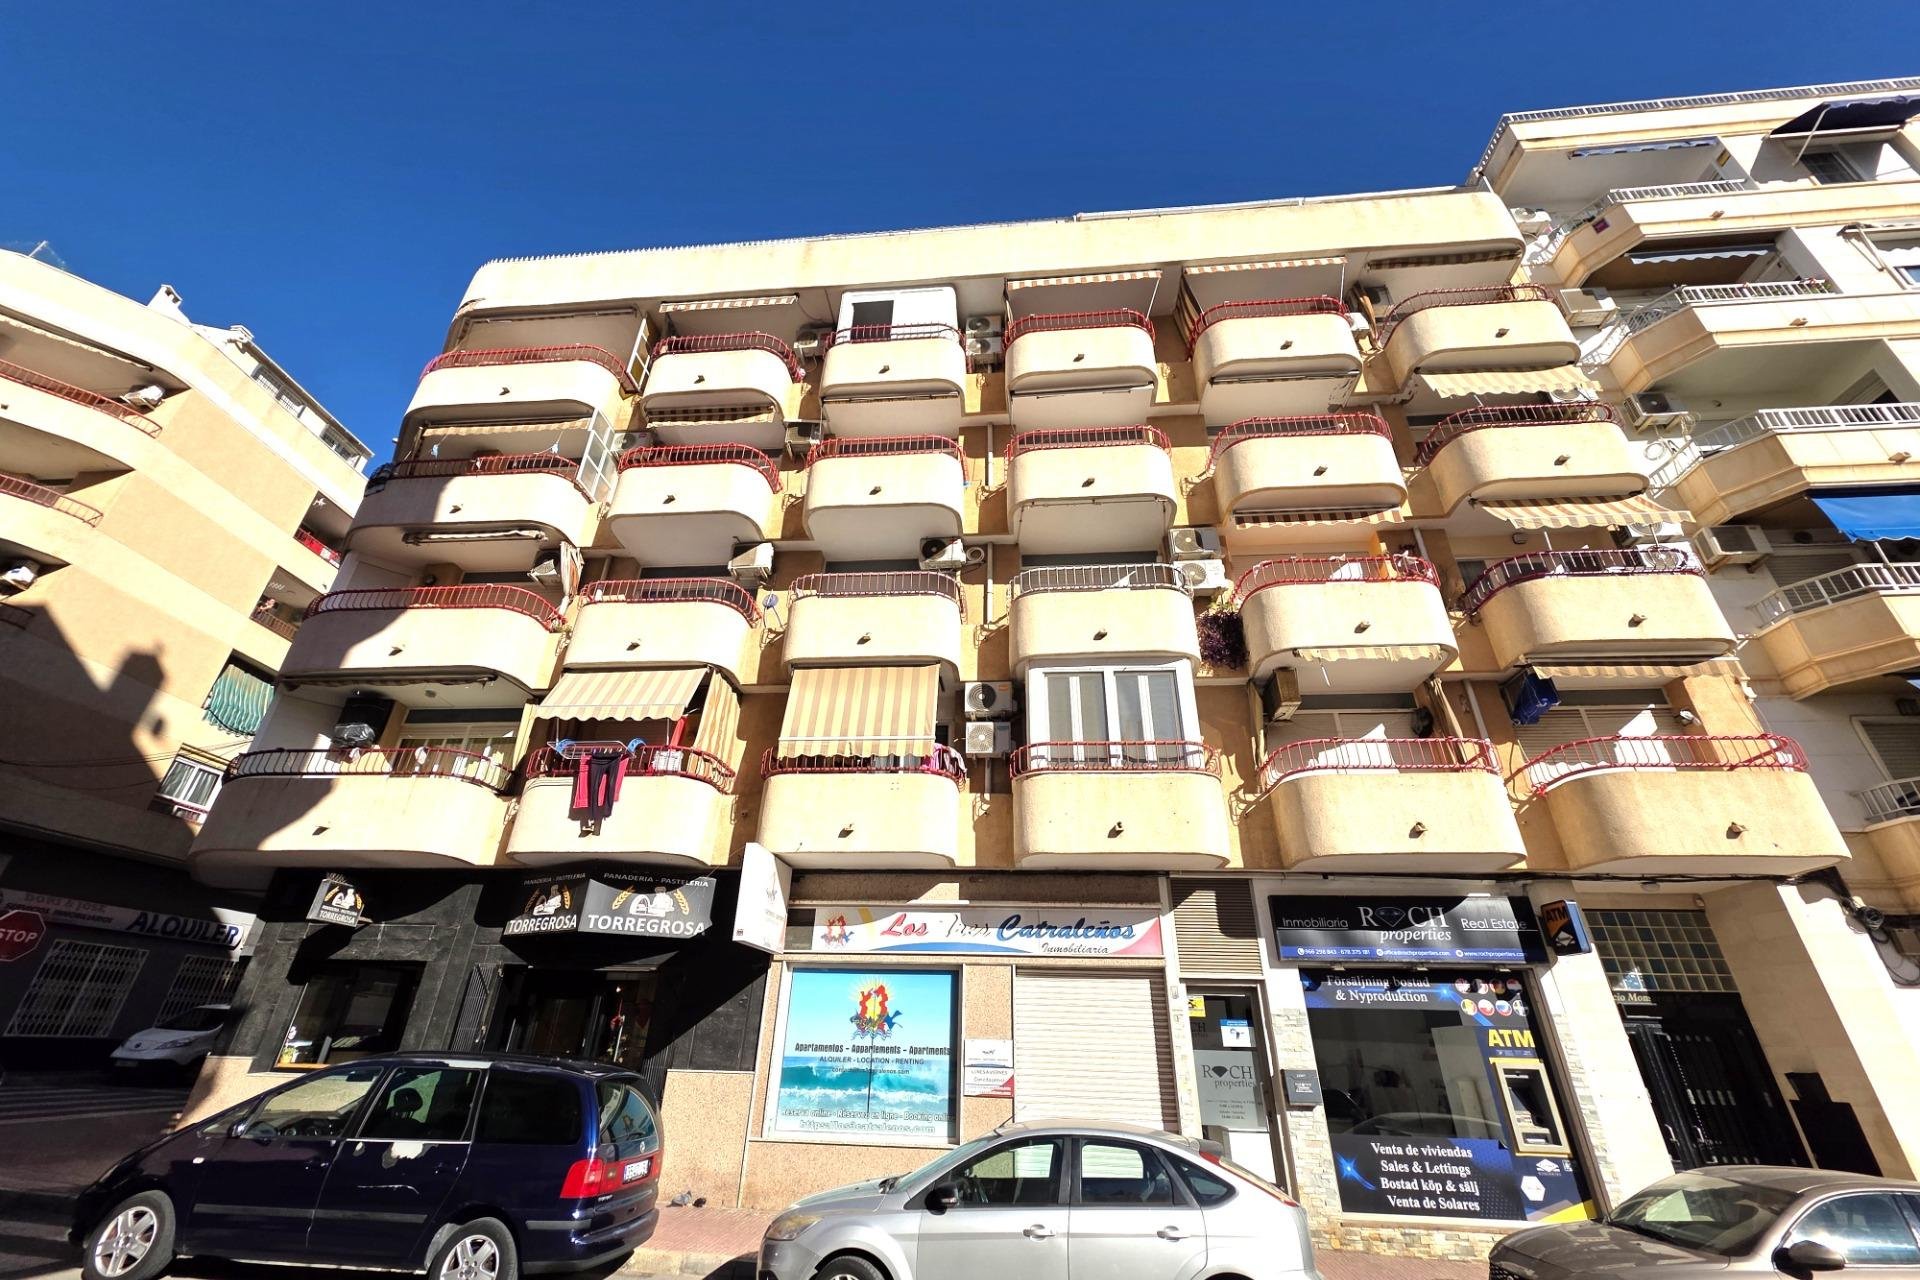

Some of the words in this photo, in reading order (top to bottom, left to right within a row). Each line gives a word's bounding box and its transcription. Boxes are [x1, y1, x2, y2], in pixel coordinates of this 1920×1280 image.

[603, 873, 654, 882] PANADERIA
[660, 878, 709, 887] PASTELERIA
[1545, 905, 1569, 921] ATM
[126, 911, 240, 945] ALQUILER
[509, 914, 578, 933] TORREGROSA
[588, 914, 706, 936] TORREGROSA
[880, 913, 929, 937] Los
[996, 914, 1137, 941] Catraleños
[1282, 917, 1349, 927] Inmobiliaria
[1460, 918, 1489, 929] Real
[1490, 918, 1528, 929] Estate
[1380, 928, 1452, 944] properties
[1041, 942, 1109, 954] Inmobiliaria
[1326, 975, 1390, 988] Försäljning
[1393, 976, 1431, 987] bostad
[1335, 989, 1346, 1001] &
[1348, 989, 1429, 1003] Nyproduktion
[1488, 1029, 1536, 1048] ATM
[795, 1042, 844, 1053] Apartamentos
[851, 1043, 902, 1054] Appartements
[908, 1045, 952, 1056] Apartments
[819, 1056, 852, 1064] ALQUILER
[856, 1056, 890, 1065] LOCATION
[895, 1057, 925, 1065] RENTING
[903, 1111, 933, 1123] Booking
[1370, 1142, 1404, 1155] Venta
[1406, 1144, 1420, 1156] de
[1420, 1145, 1473, 1158] viviendas
[1380, 1160, 1410, 1172] Sales
[1411, 1161, 1423, 1173] &
[1424, 1161, 1471, 1178] Lettings
[1380, 1177, 1420, 1190] Bostad
[1420, 1179, 1443, 1194] köp
[1445, 1180, 1457, 1192] &
[1458, 1181, 1480, 1196] sälj
[1386, 1195, 1421, 1208] Venta
[1422, 1196, 1437, 1209] de
[1438, 1197, 1481, 1211] Solares
